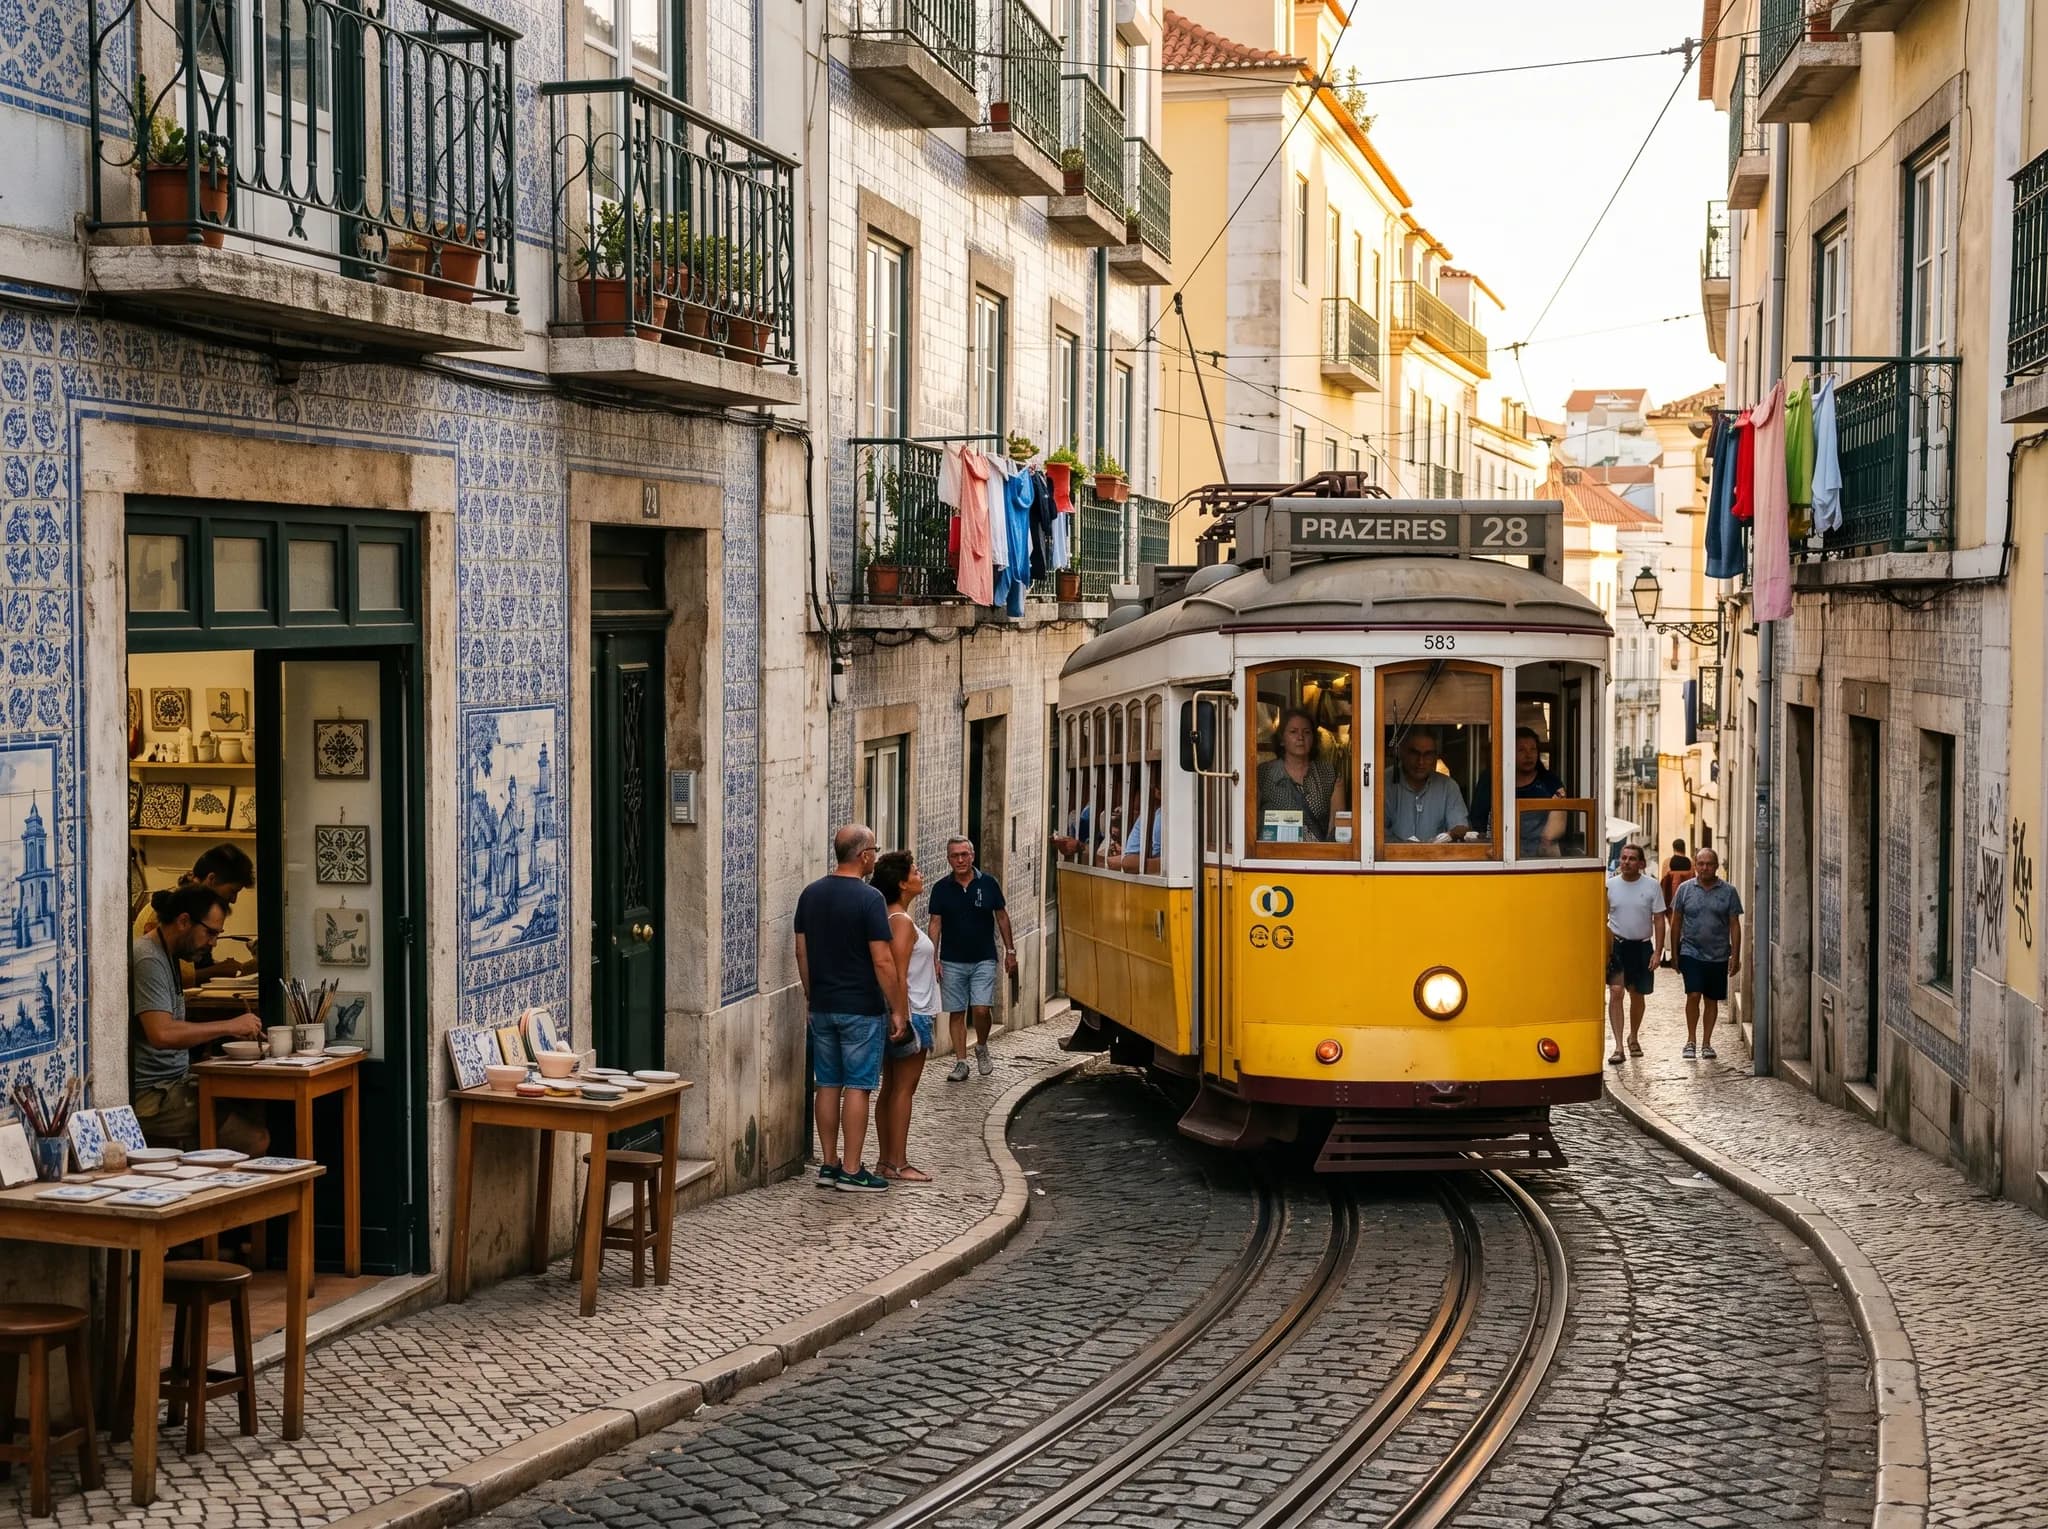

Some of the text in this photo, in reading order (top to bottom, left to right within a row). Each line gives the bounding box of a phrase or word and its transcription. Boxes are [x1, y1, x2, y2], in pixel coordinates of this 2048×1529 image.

[1301, 516, 1529, 547] PRAZERES 28
[1424, 634, 1456, 650] 583
